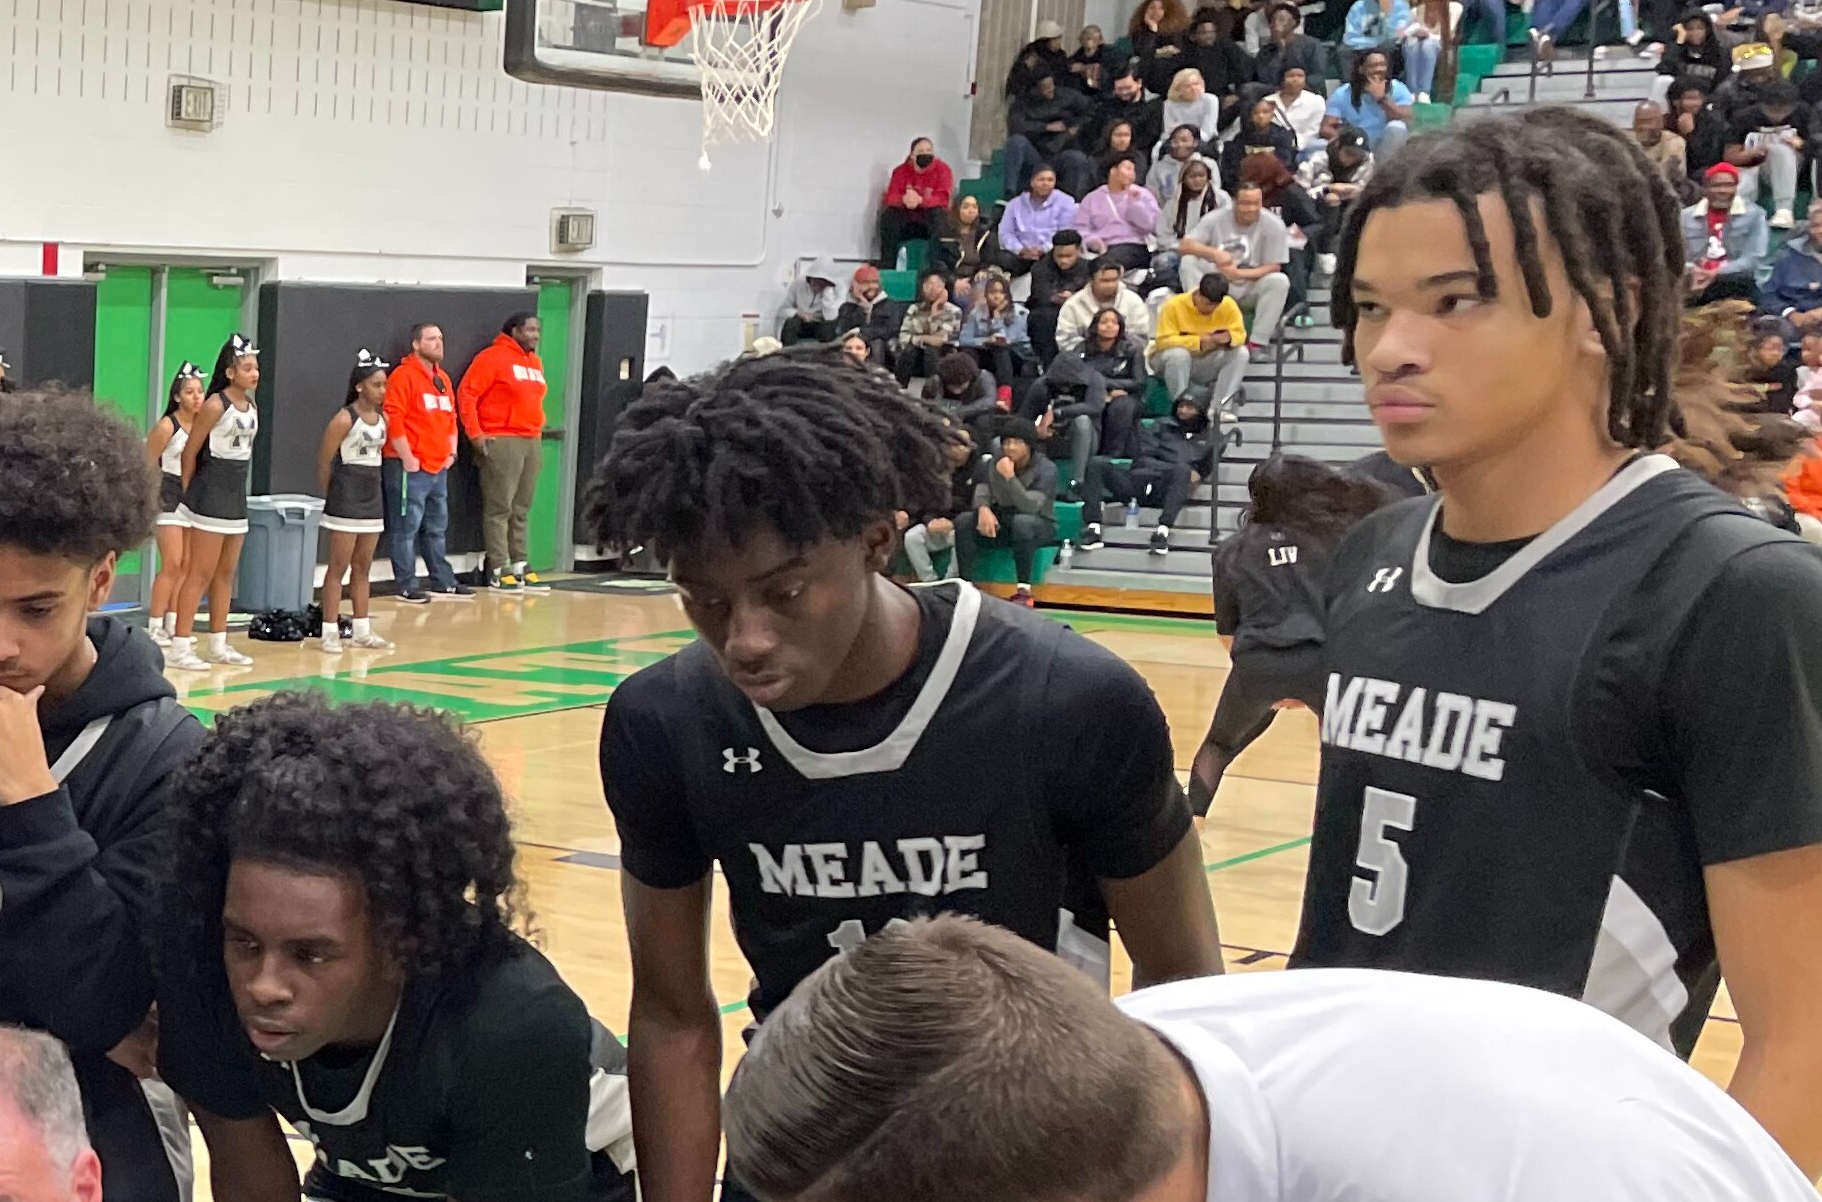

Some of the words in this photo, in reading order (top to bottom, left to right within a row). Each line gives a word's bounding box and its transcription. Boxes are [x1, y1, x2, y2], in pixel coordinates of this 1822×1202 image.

[1321, 672, 1518, 782] MEADE
[749, 833, 989, 899] MEADE
[1347, 786, 1418, 937] 5
